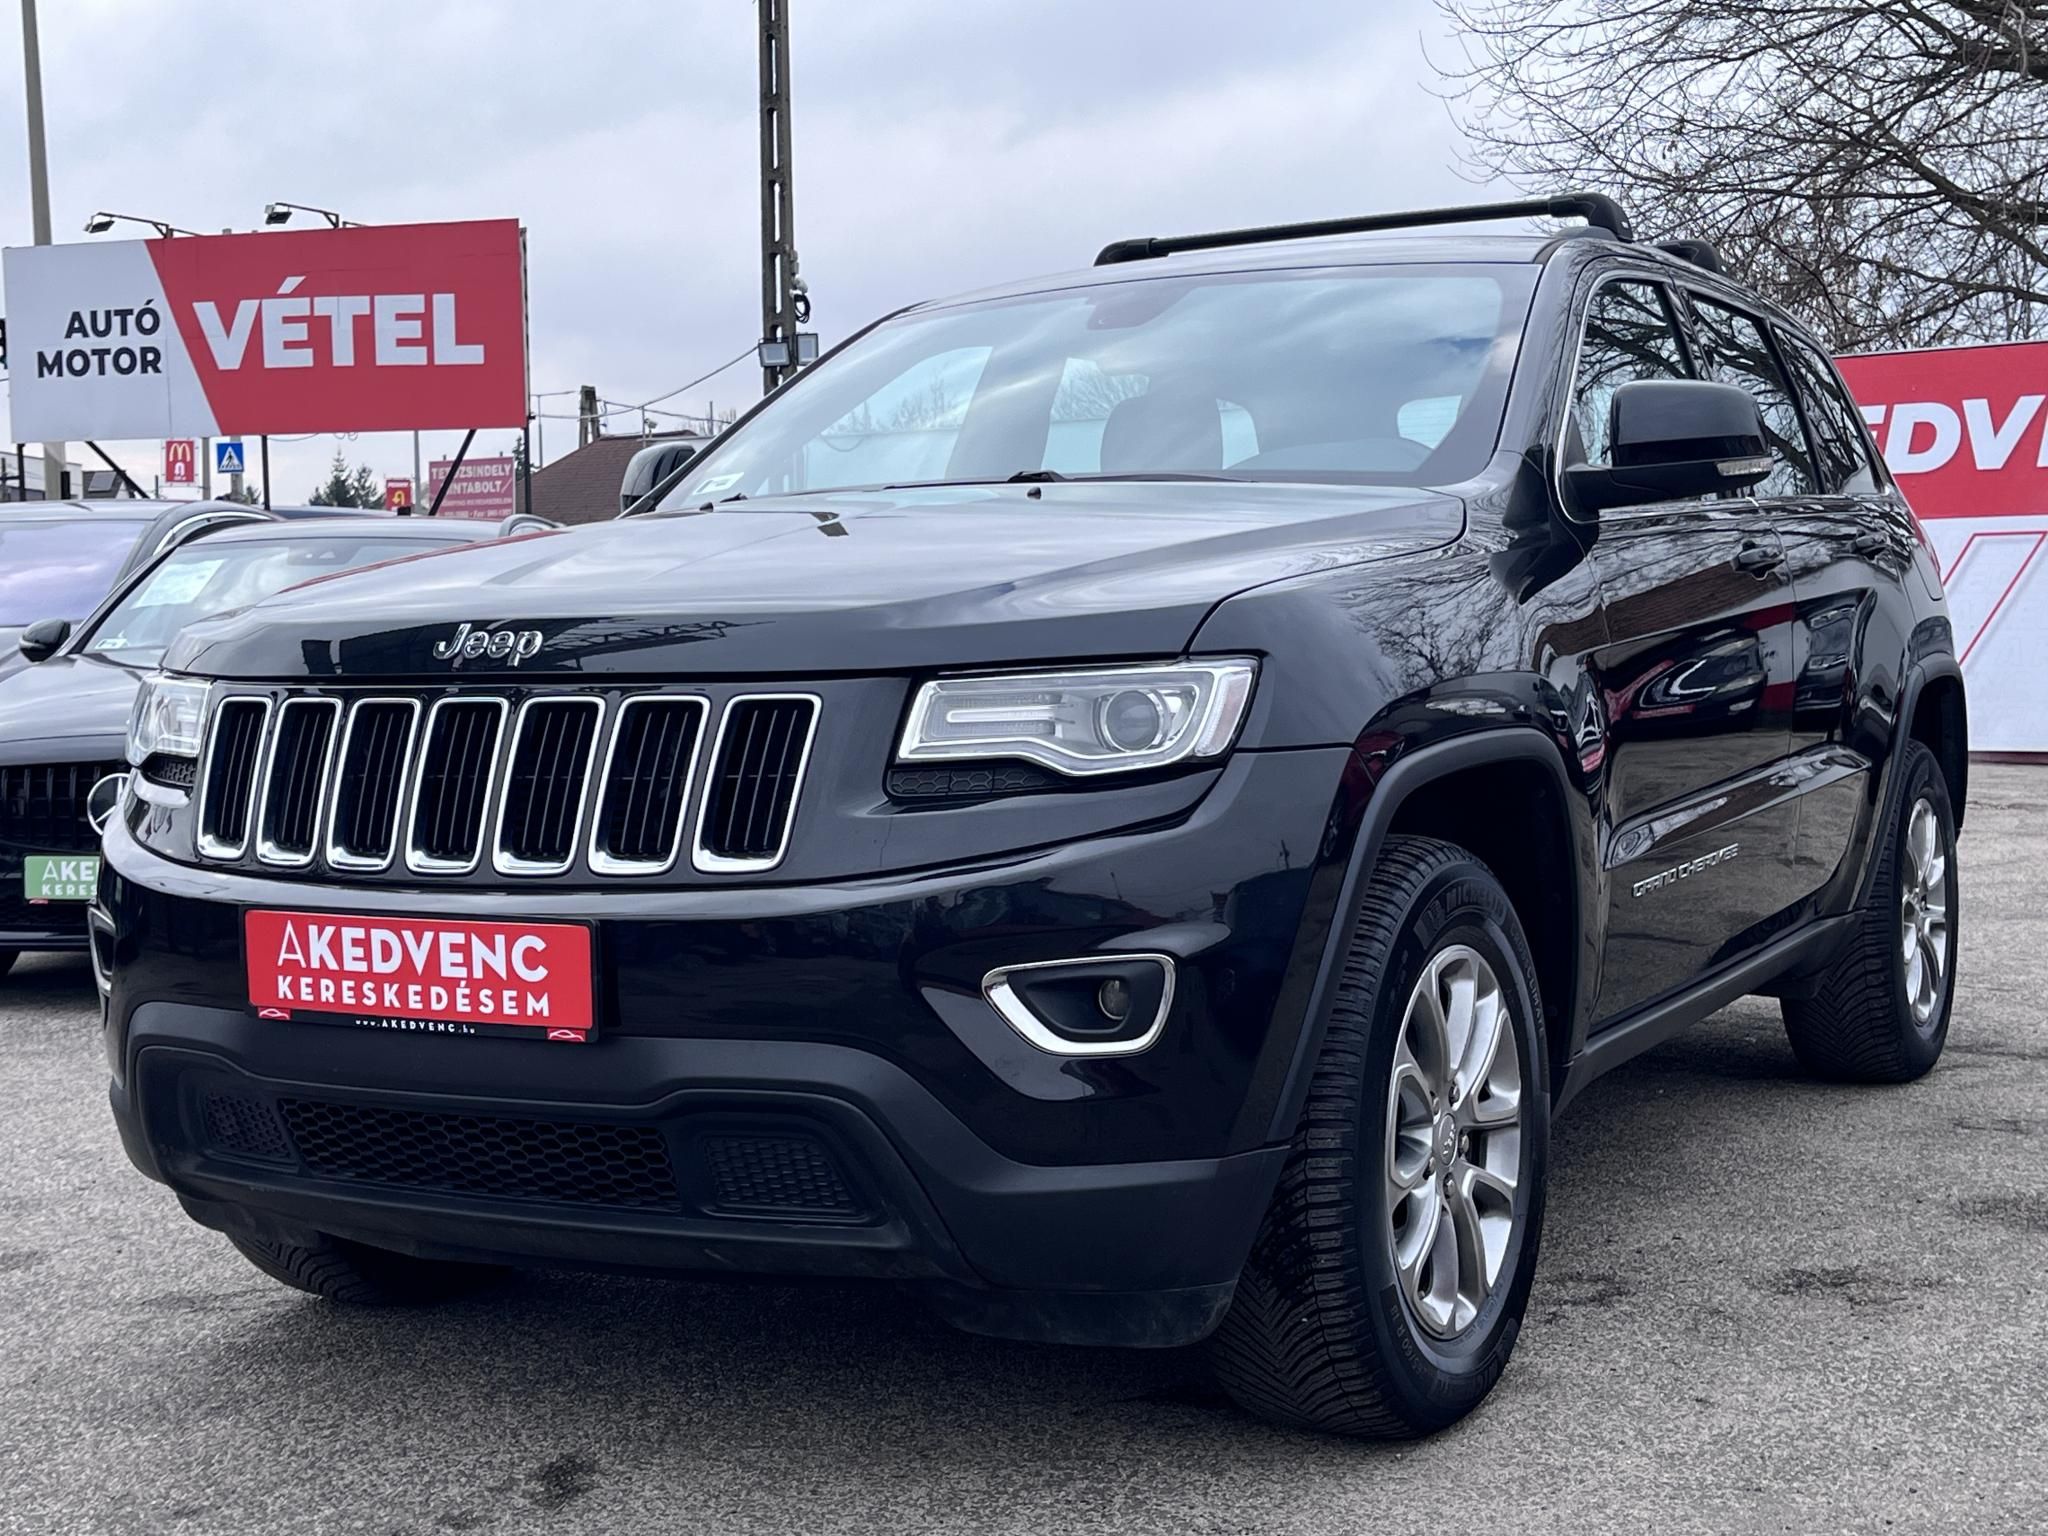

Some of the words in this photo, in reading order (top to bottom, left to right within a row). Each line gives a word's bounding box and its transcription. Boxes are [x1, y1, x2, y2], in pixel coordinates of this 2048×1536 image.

[64, 298, 160, 339] AUTÓ
[192, 275, 485, 370] VÉTEL
[36, 346, 162, 379] MOTOR
[433, 623, 543, 667] Jeep
[42, 860, 100, 882] AKE
[277, 919, 549, 983] AKEDVENC
[277, 974, 550, 1017] KERESKEDÉSEM
